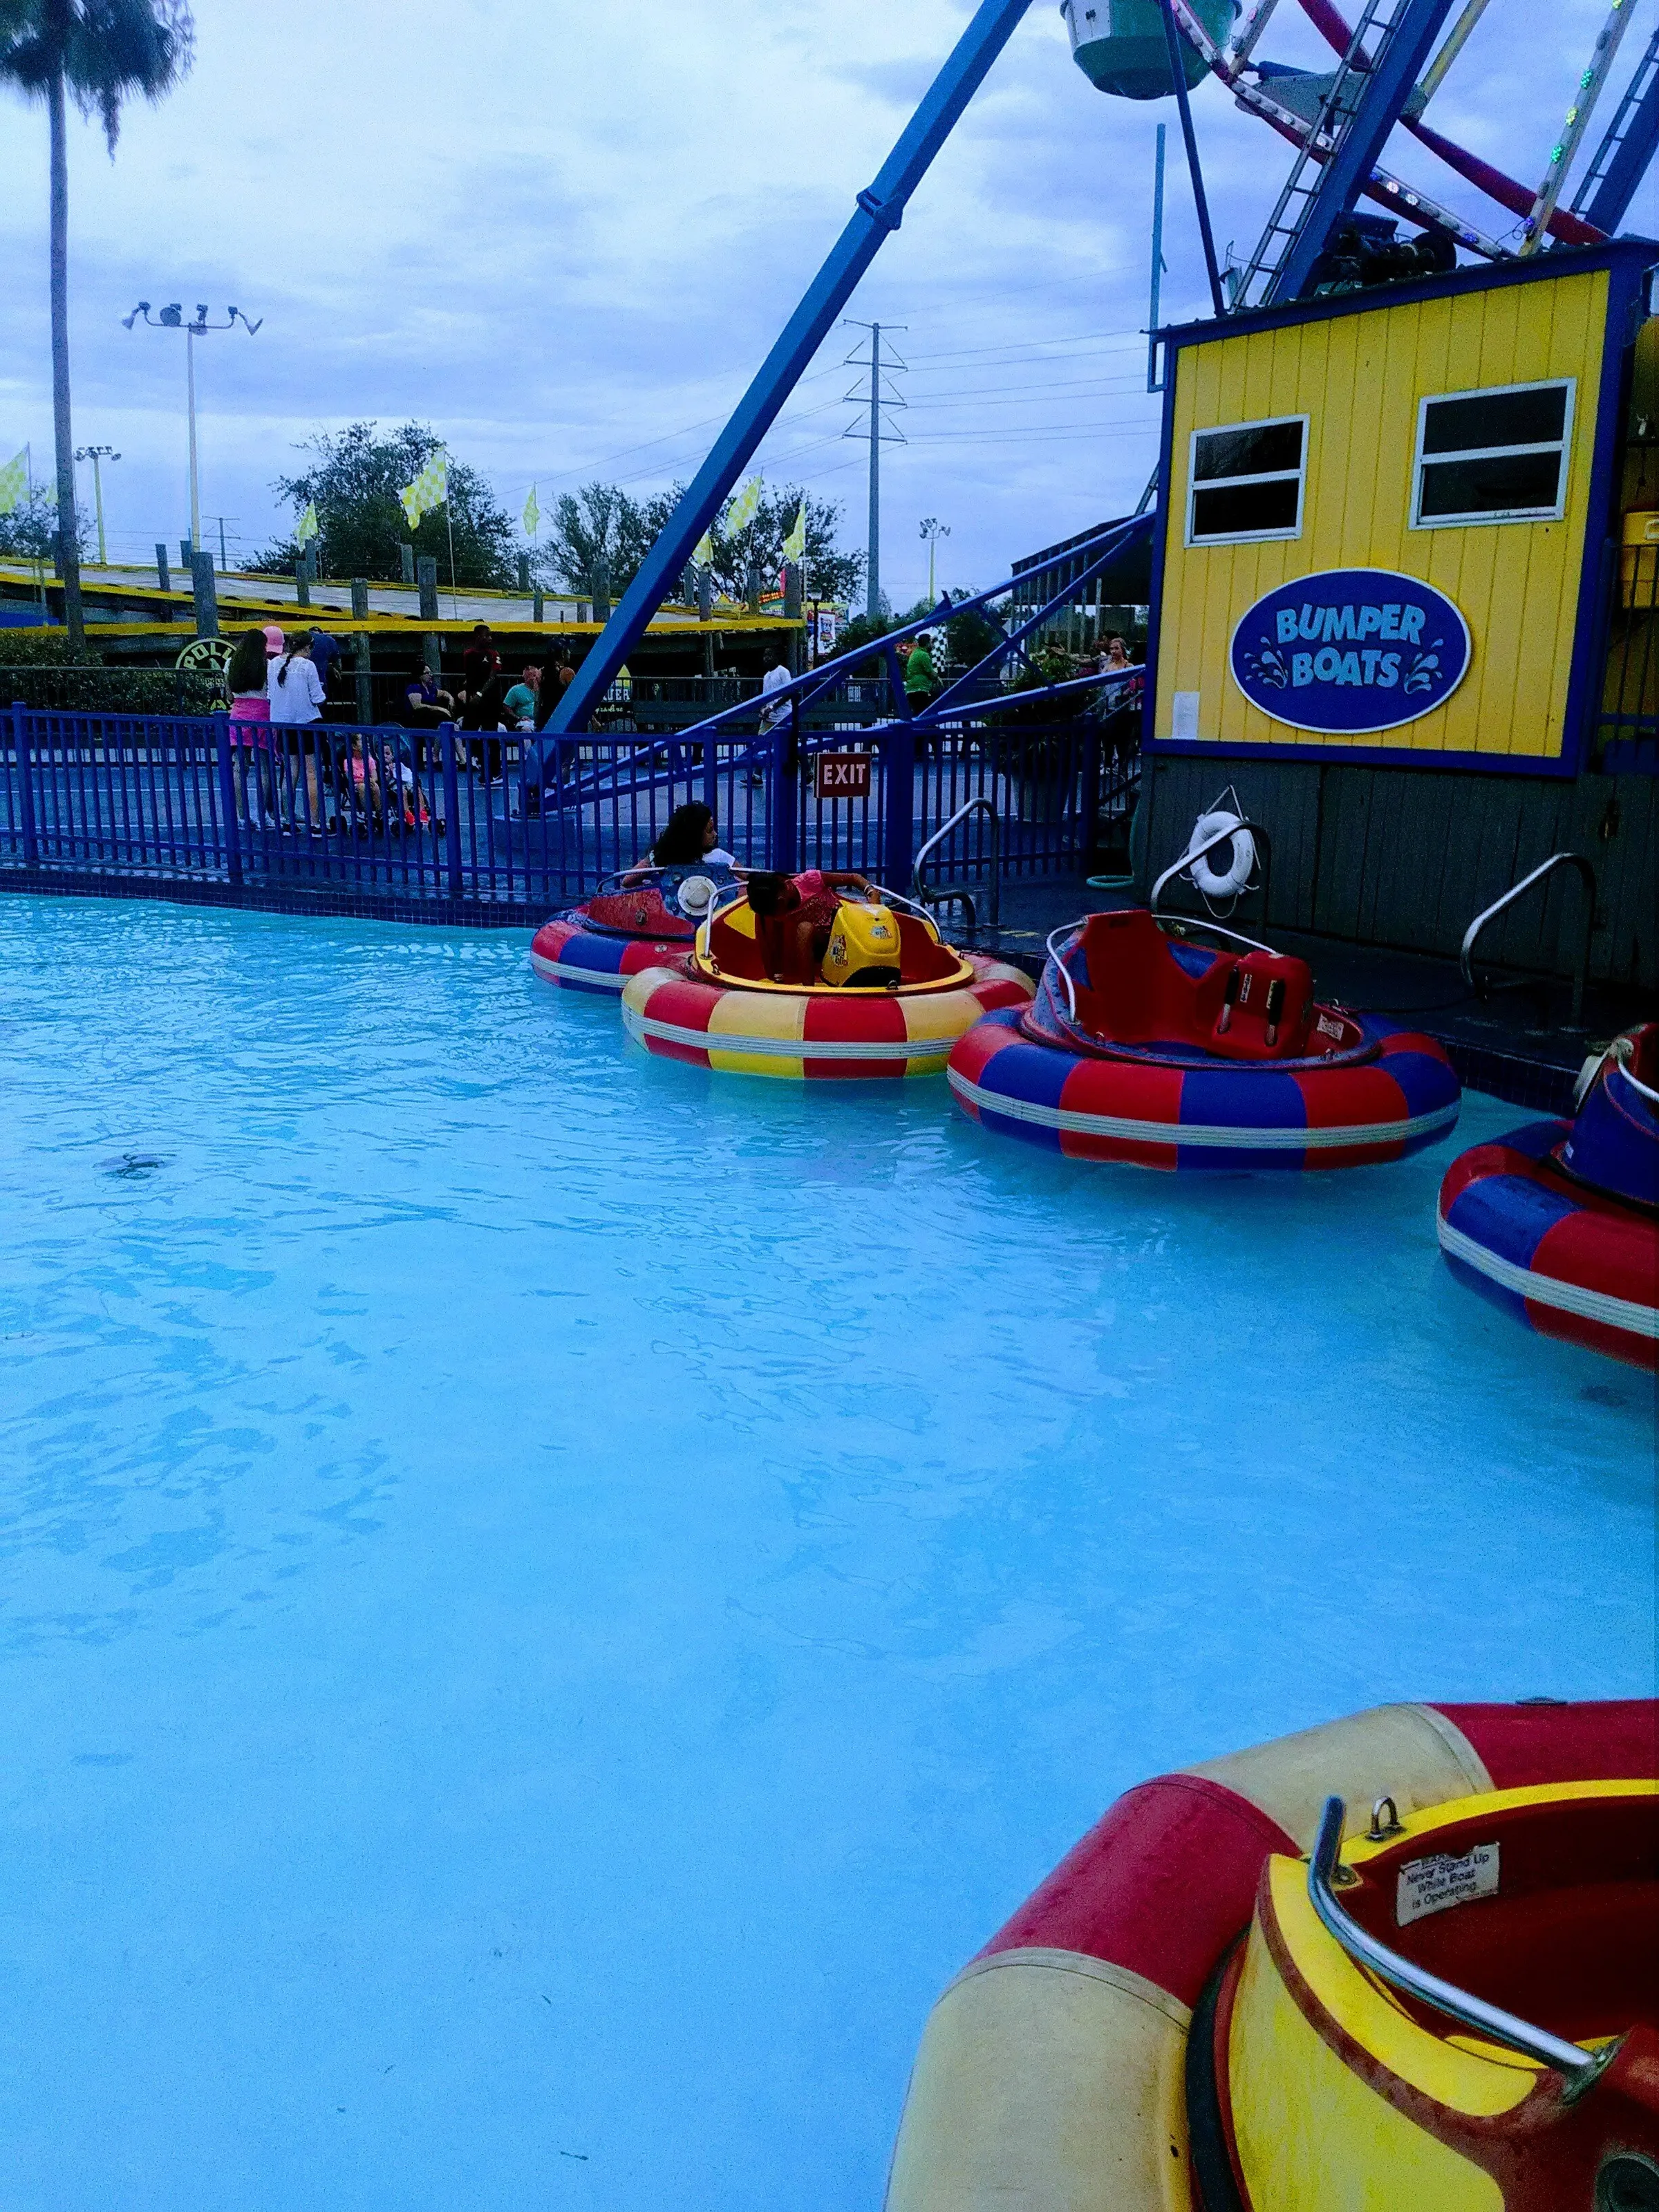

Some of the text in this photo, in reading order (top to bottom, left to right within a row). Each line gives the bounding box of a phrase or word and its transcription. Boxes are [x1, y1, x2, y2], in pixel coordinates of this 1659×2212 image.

[1276, 603, 1426, 645] BUMPER
[1292, 646, 1402, 687] BOATS
[823, 764, 866, 785] EXIT
[1406, 1868, 1435, 1884] Never
[1438, 1859, 1470, 1873] Stand
[1474, 1854, 1489, 1865] Up
[1418, 1868, 1476, 1893] While Boat
[1424, 1882, 1477, 1905] Operating
